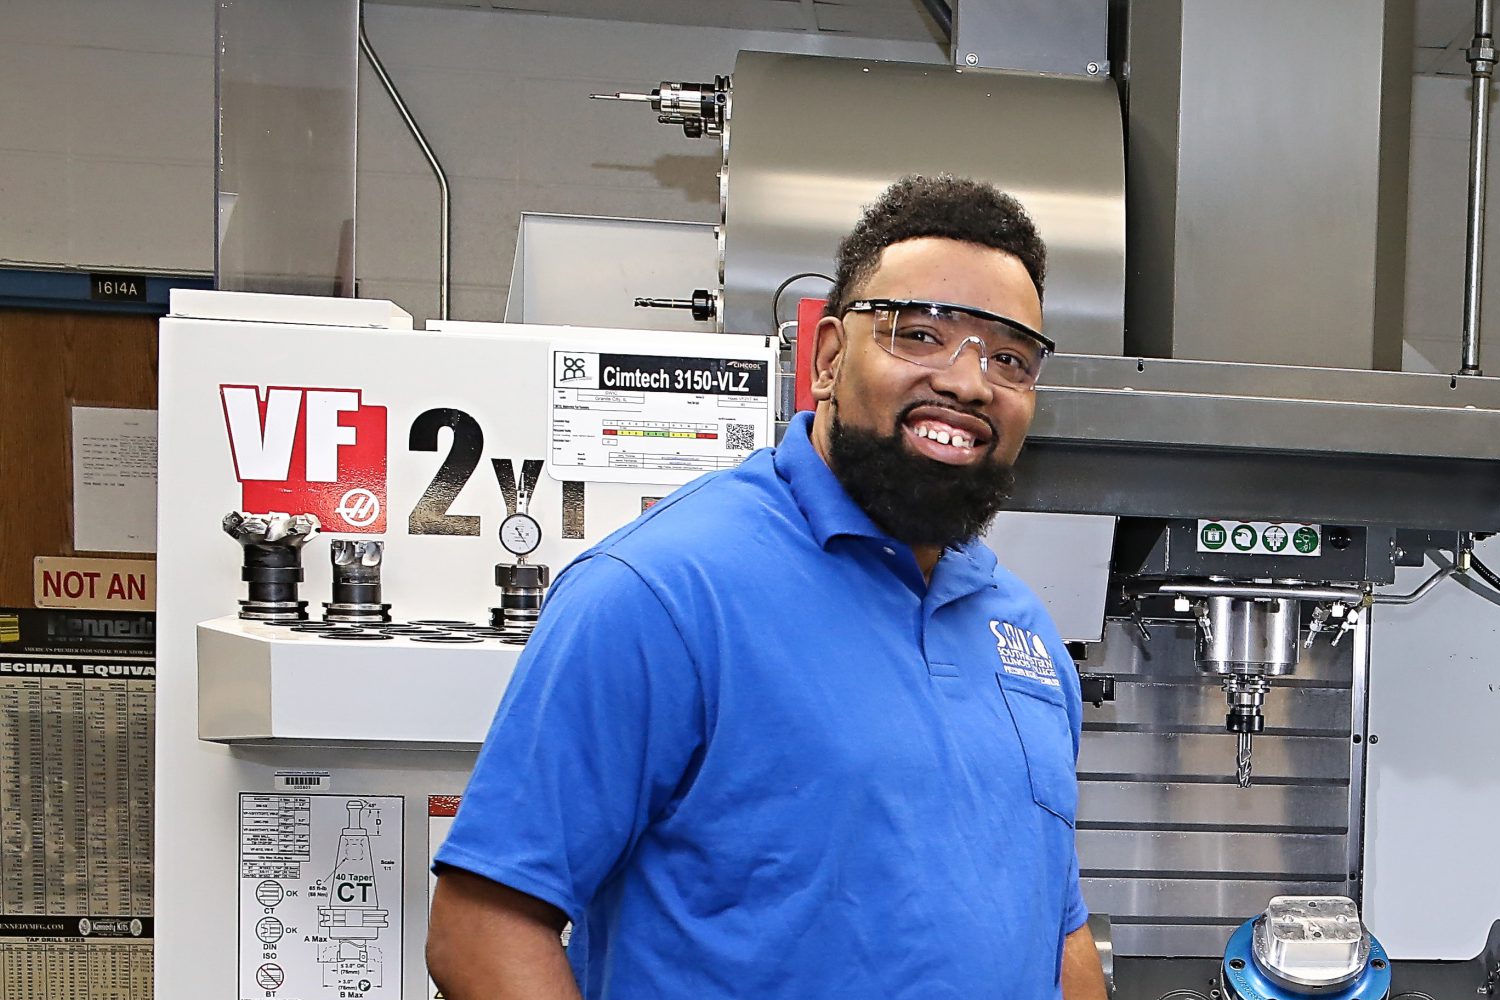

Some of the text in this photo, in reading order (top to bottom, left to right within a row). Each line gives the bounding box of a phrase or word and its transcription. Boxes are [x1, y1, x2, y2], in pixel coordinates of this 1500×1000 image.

[98, 280, 138, 296] 1614A
[603, 365, 750, 392] Cimtech 3150-VLZ
[219, 386, 361, 483] VF
[42, 570, 146, 601] NOT AN
[336, 873, 373, 883] 40 Taper
[337, 882, 373, 903] CT
